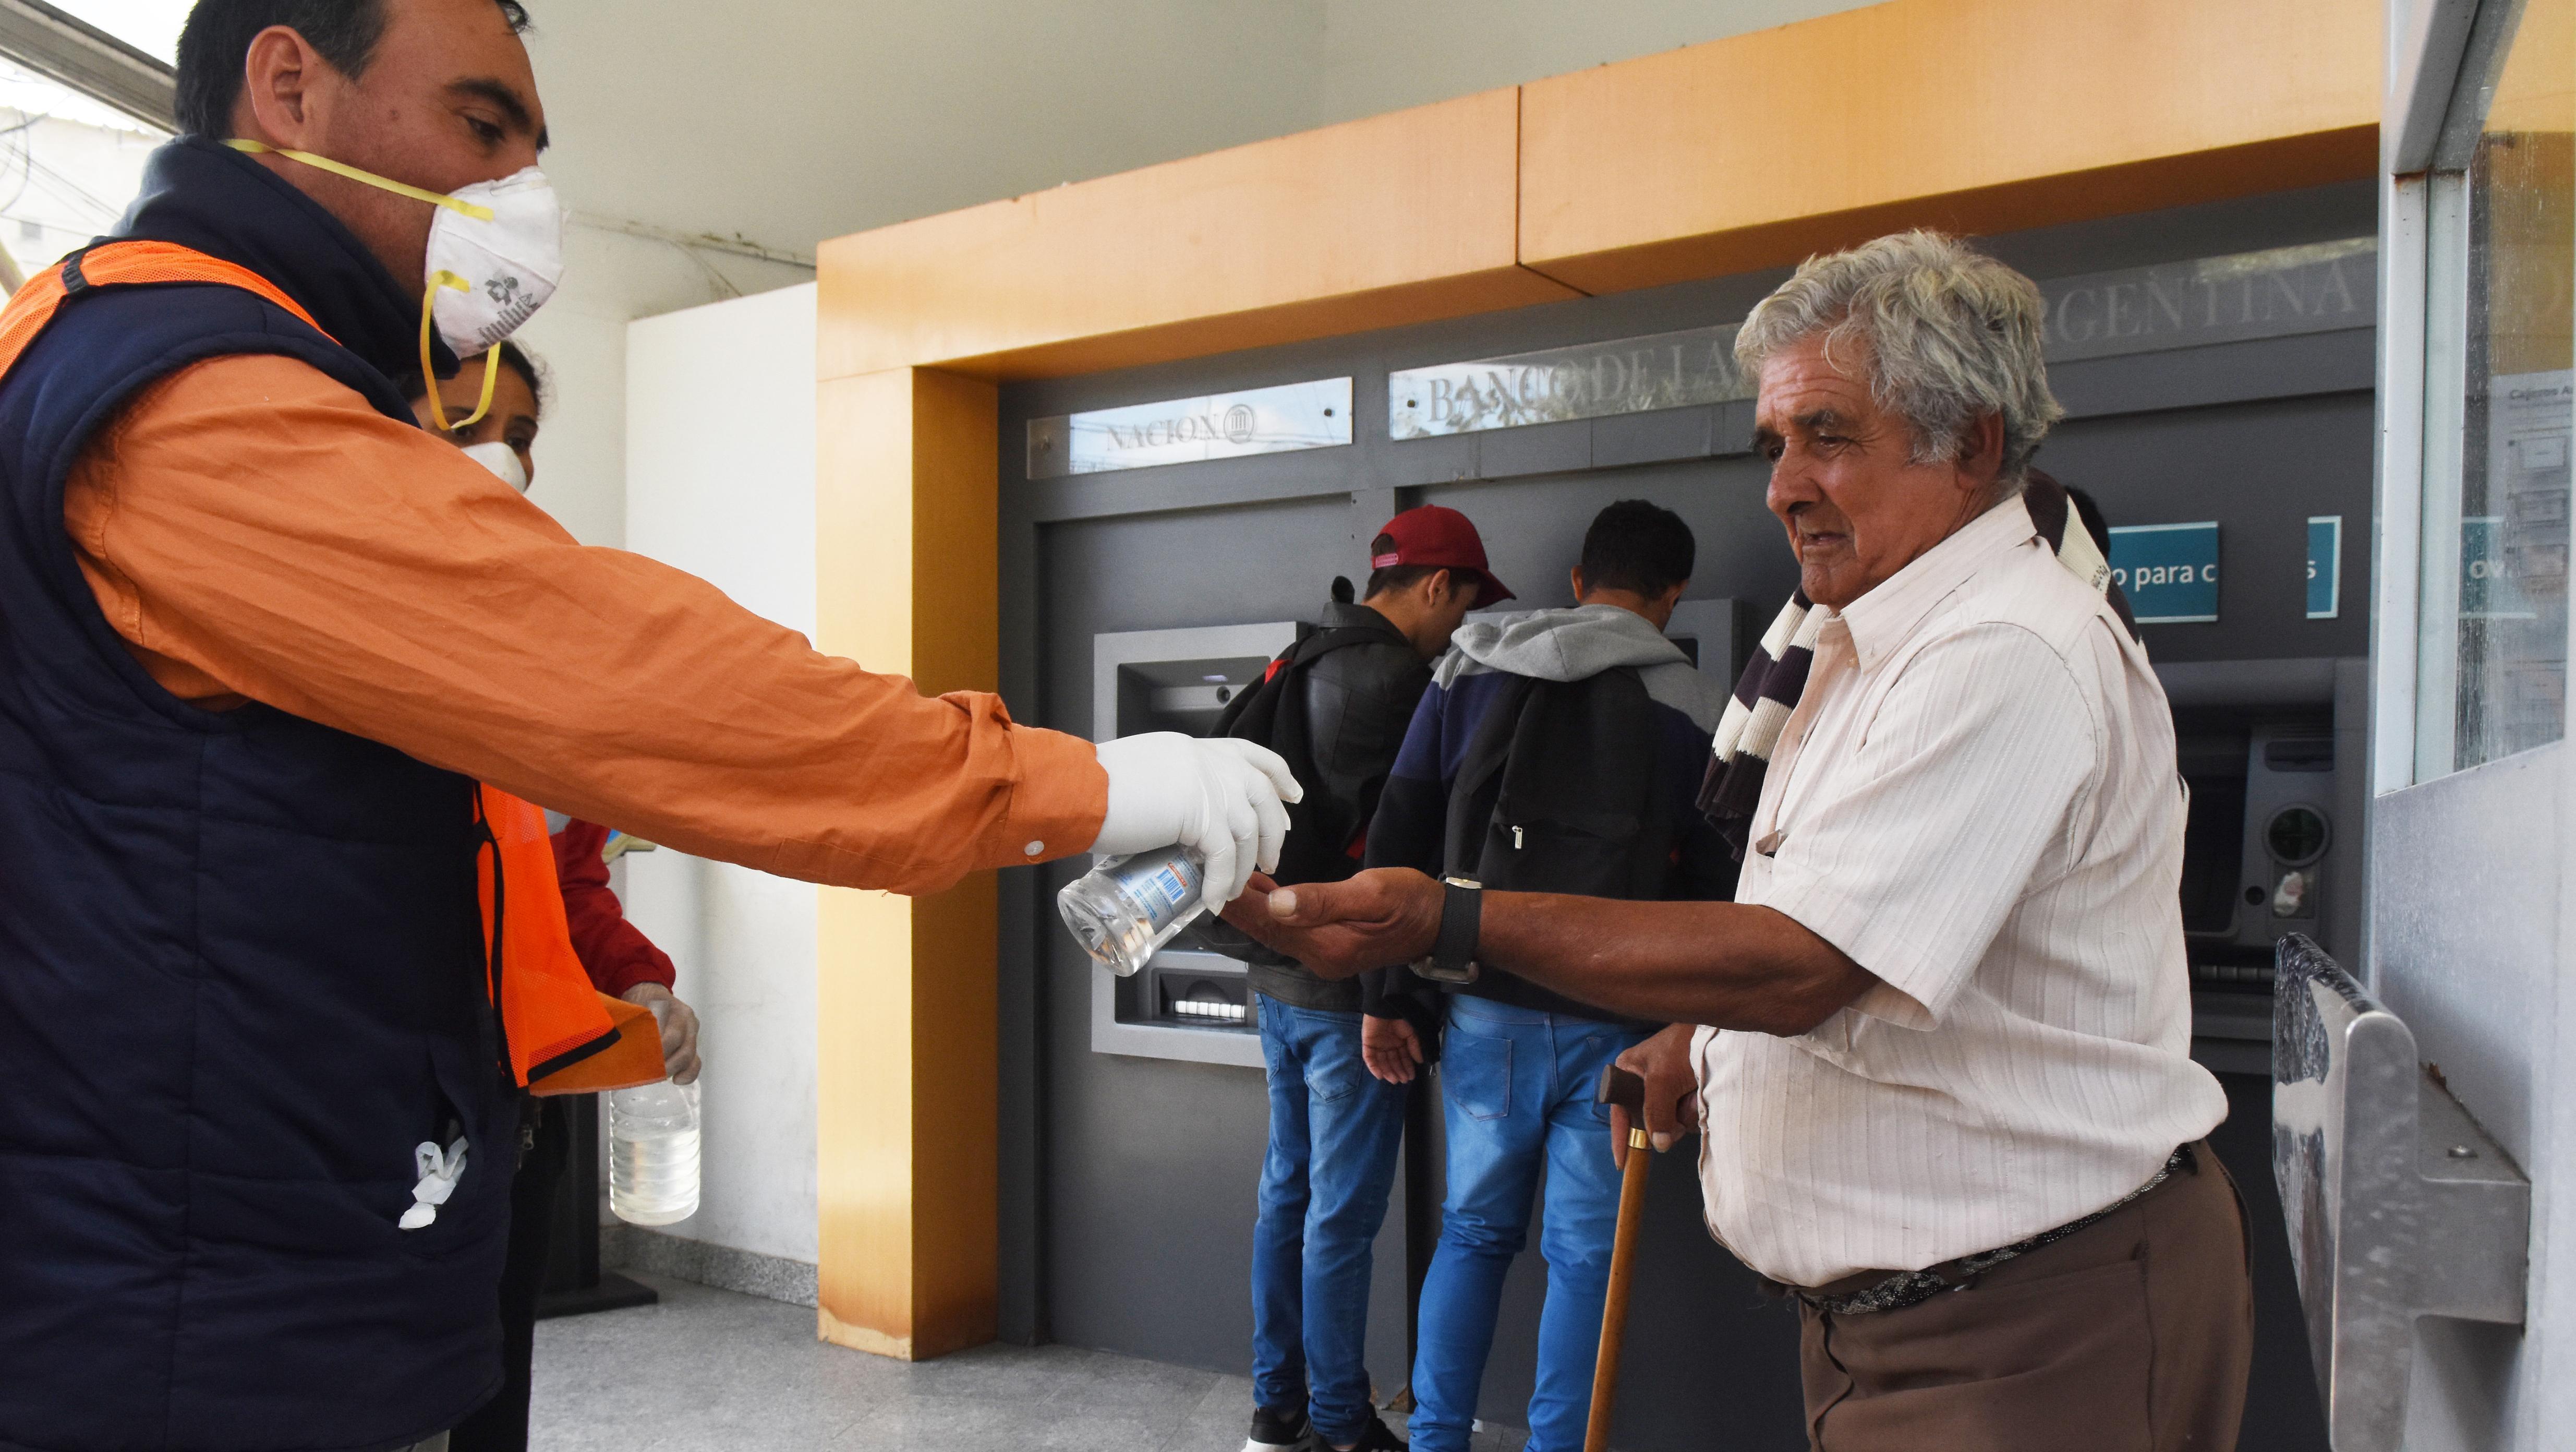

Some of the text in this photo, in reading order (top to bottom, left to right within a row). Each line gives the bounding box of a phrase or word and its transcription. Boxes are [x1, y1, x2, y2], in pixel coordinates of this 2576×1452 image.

[1428, 260, 2355, 422] BANCO DE LA GENTINA
[1107, 413, 1218, 451] NACION
[2135, 564, 2194, 592] para
